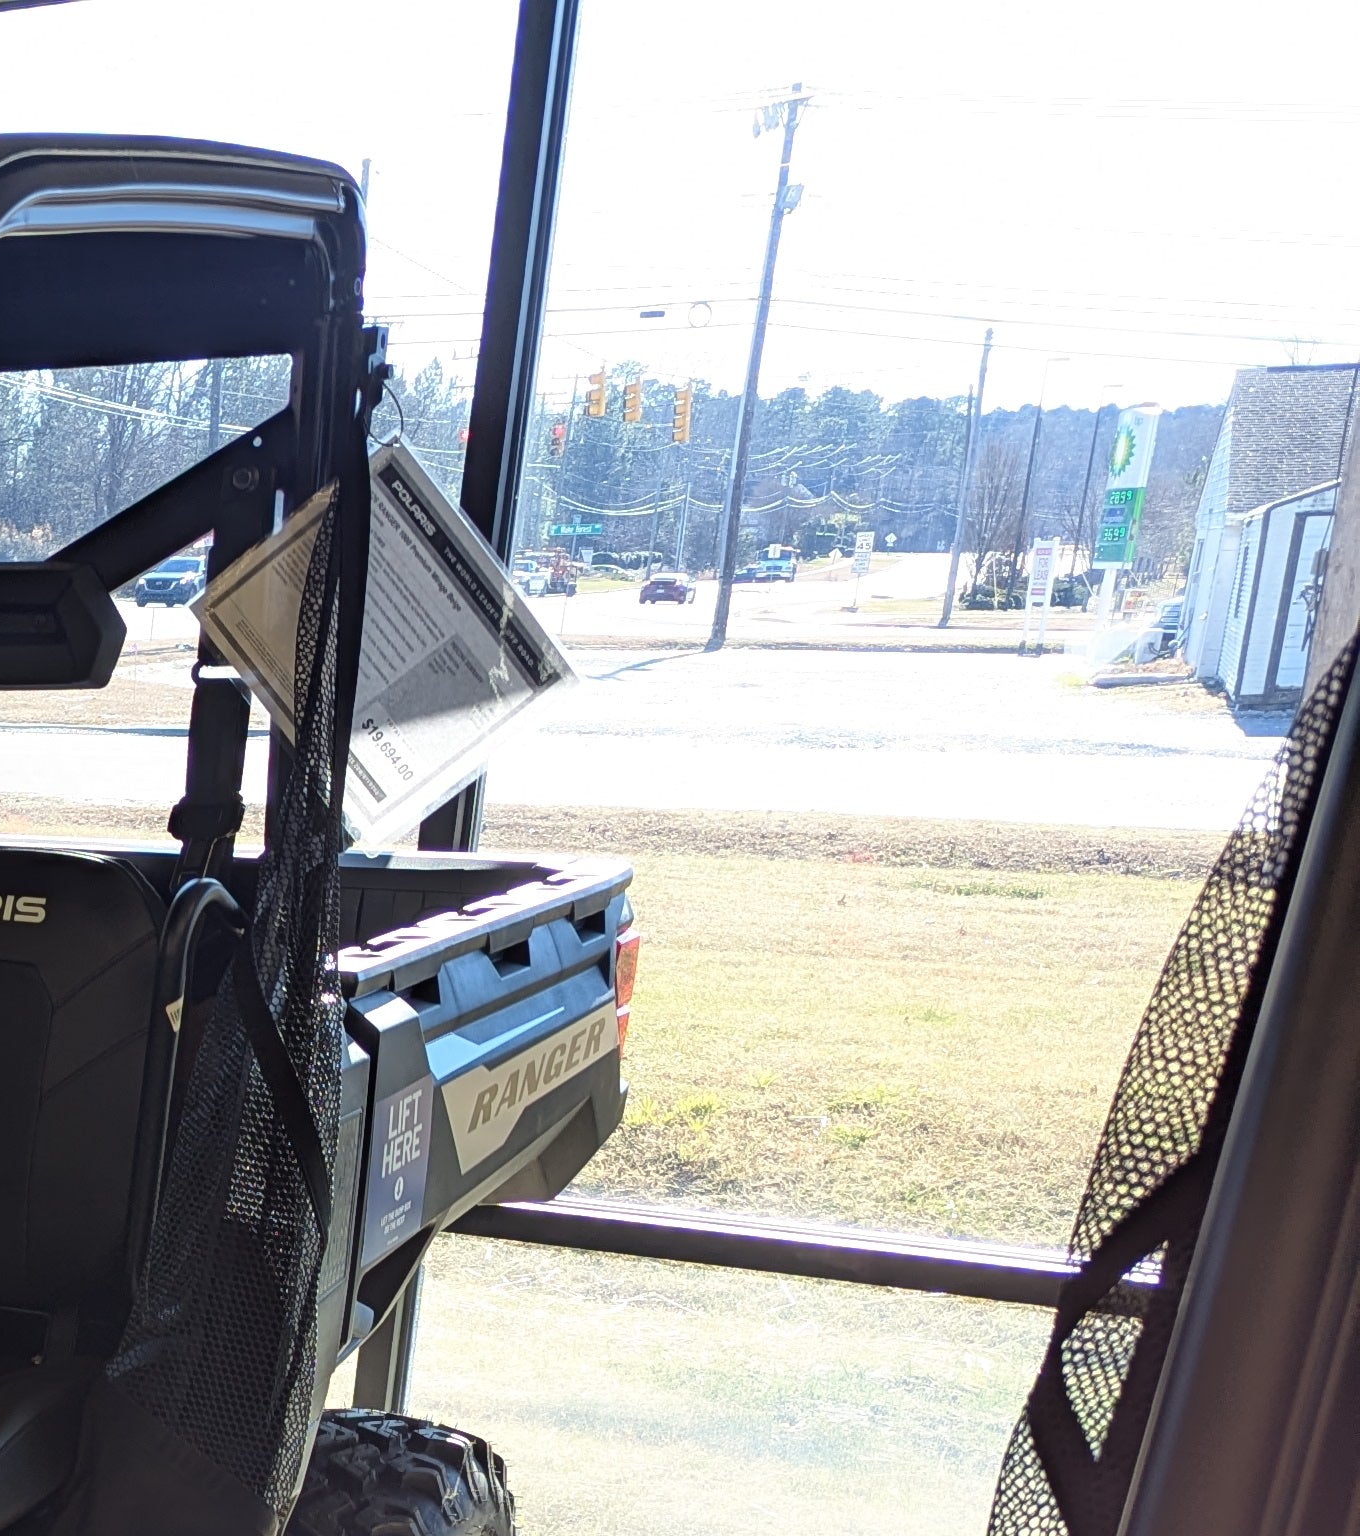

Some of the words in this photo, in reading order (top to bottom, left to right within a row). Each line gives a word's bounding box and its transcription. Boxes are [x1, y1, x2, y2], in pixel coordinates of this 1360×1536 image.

[389, 479, 438, 537] POLARIS
[857, 542, 872, 550] 45
[454, 562, 478, 590] WORLD
[474, 589, 501, 619] LEADER
[362, 718, 414, 781] $19,694.00
[468, 1017, 607, 1134] RANGER
[388, 1089, 422, 1140] LIFT
[382, 1124, 422, 1179] HERE
